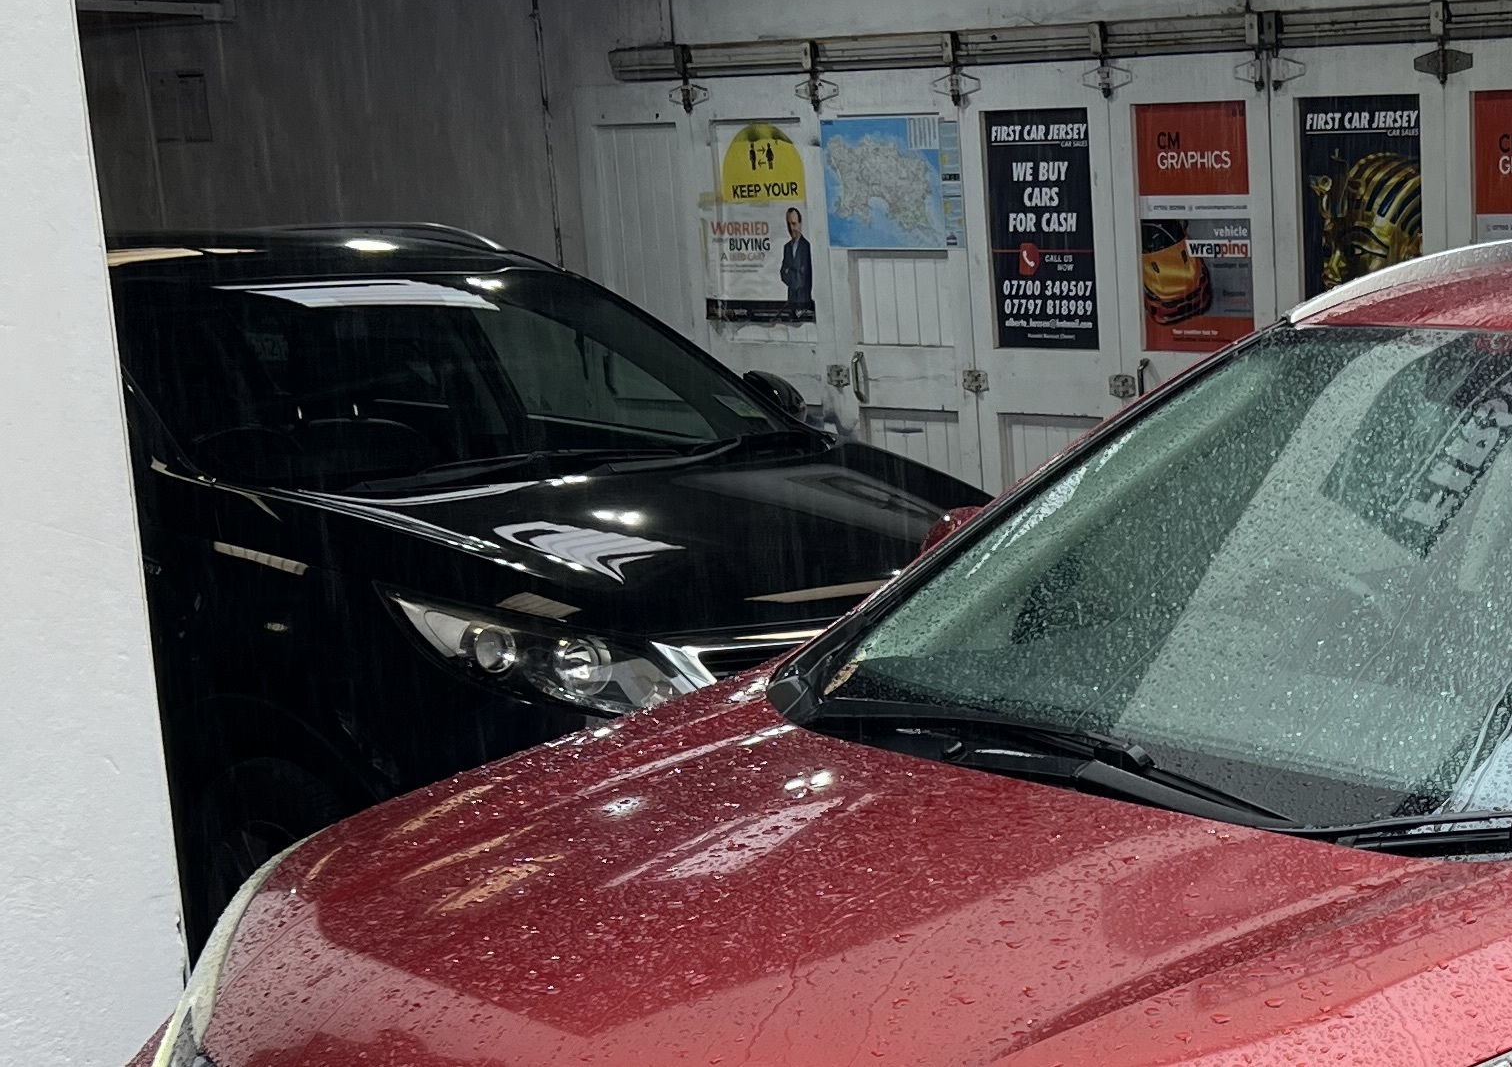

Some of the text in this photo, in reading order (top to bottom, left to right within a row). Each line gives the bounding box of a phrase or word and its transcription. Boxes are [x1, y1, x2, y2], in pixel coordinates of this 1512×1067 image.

[1305, 110, 1419, 131] FIRST CAR JERSEY
[991, 123, 1087, 142] FIRST CAR JERSEY
[1157, 132, 1180, 150] CM
[1060, 140, 1072, 148] CAR
[1157, 150, 1231, 170] GRAPHICS
[1012, 161, 1068, 182] WE BUY
[731, 181, 798, 199] KEEP YOUR
[1023, 187, 1059, 207] CARS
[711, 221, 769, 236] WORRIED
[1008, 212, 1077, 233] FOR CASH
[1213, 226, 1248, 237] vehicle
[728, 237, 771, 251] BUYING
[1189, 239, 1249, 258] wrapping
[720, 252, 729, 261] A
[1045, 255, 1062, 263] CALL
[1057, 264, 1074, 272] NOW
[1003, 280, 1092, 297] 07700 349507
[1004, 299, 1093, 316] 07797 818989
